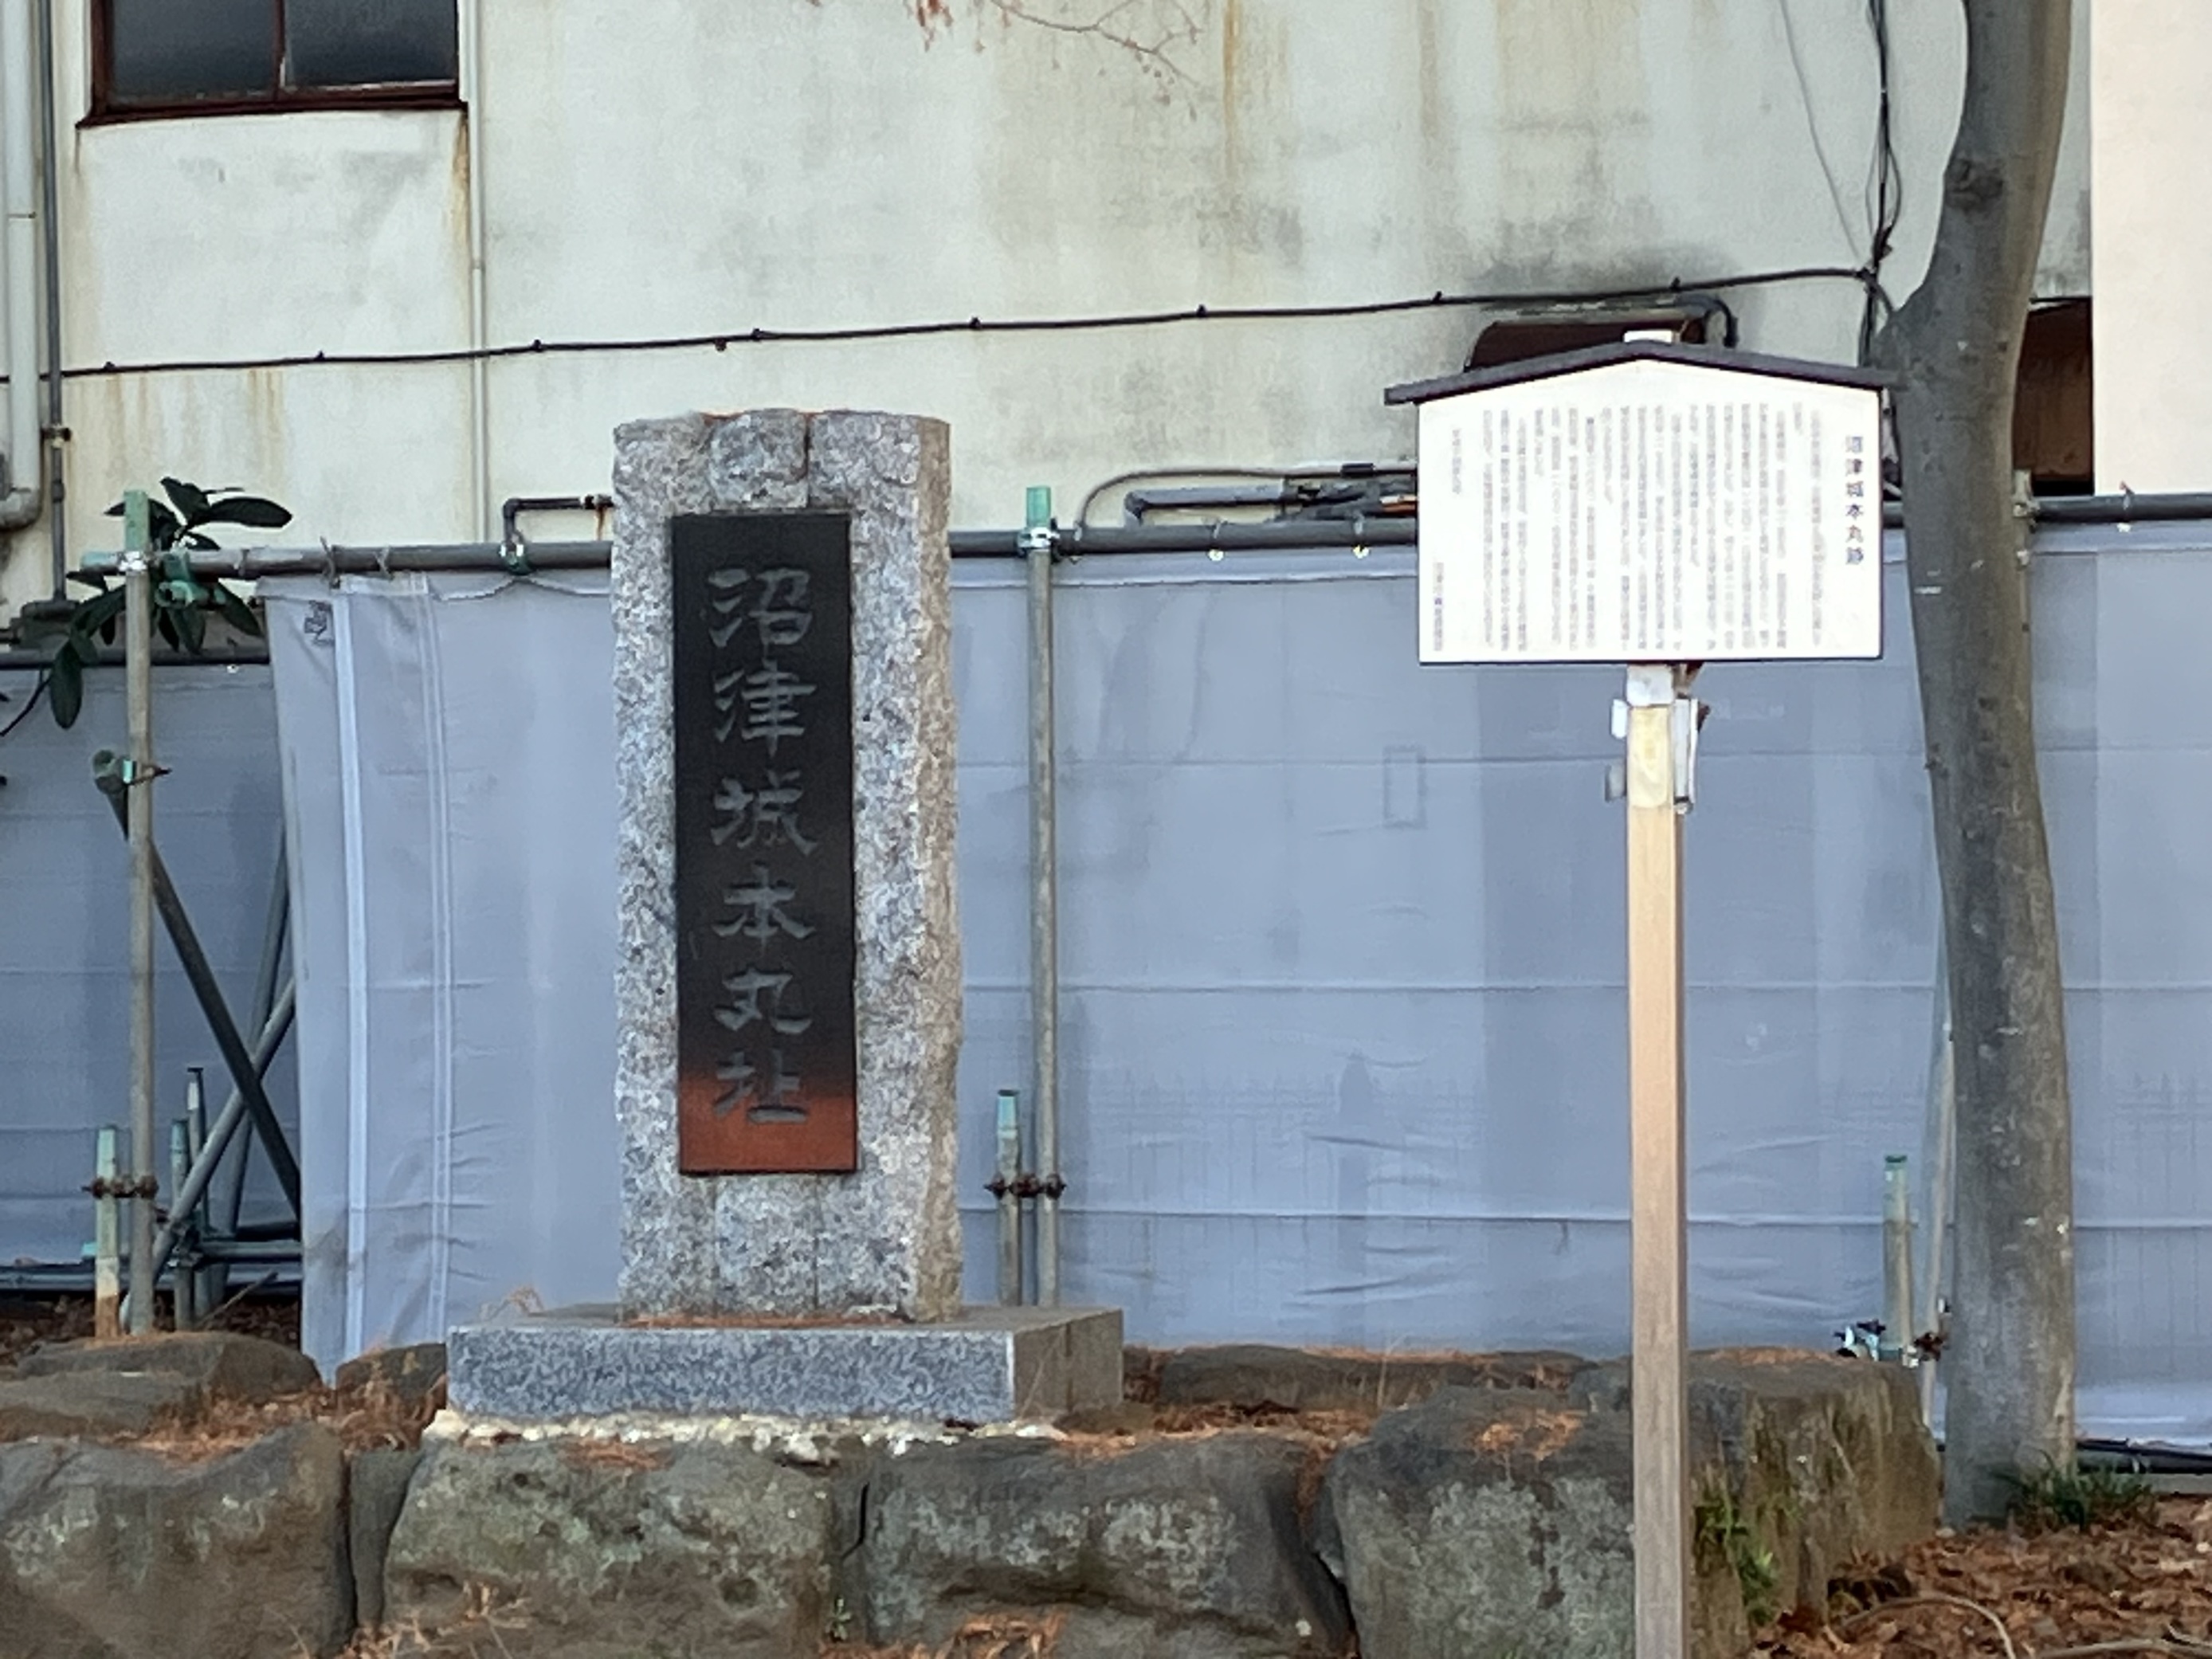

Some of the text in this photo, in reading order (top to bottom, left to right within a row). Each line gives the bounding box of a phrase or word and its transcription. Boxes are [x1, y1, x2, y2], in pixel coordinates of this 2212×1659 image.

[708, 567, 818, 1124] 沼津城本丸址
